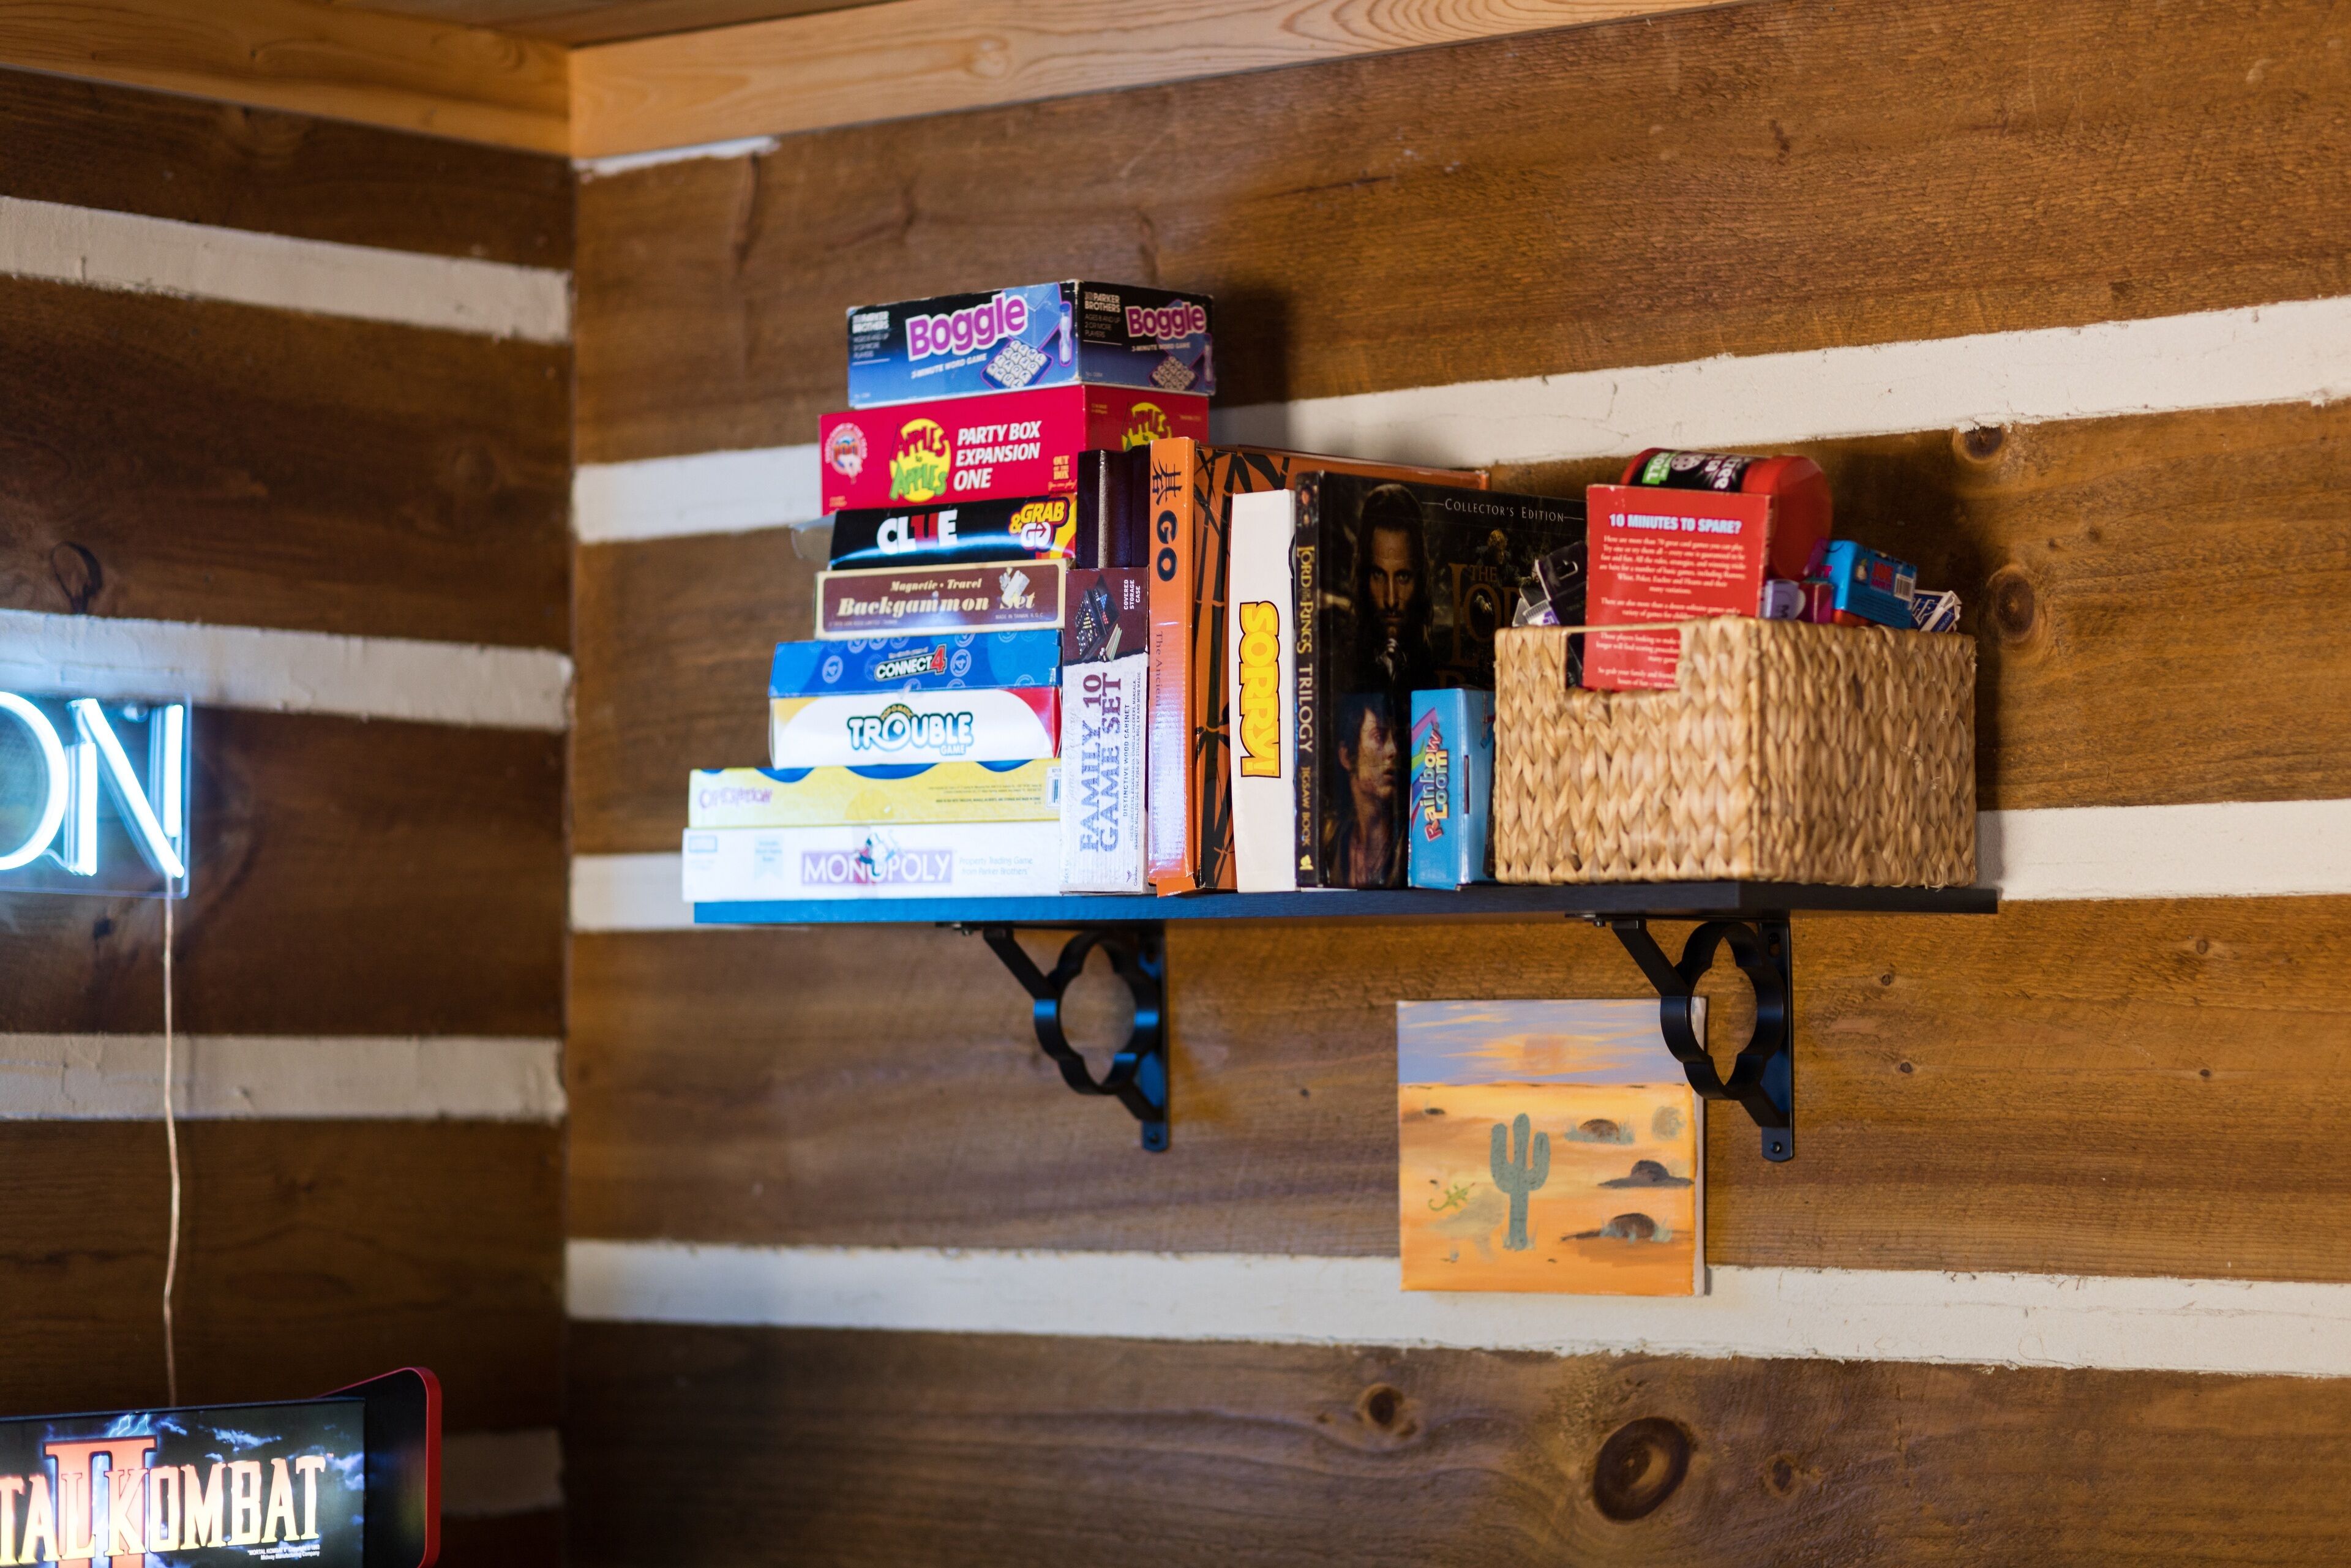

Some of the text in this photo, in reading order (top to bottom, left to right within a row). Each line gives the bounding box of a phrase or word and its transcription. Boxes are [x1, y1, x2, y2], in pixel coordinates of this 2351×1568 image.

[1084, 301, 1120, 313] BROTHERS
[1093, 292, 1120, 303] PARKER
[906, 292, 1029, 362] Boggle
[1125, 301, 1207, 340] Boggle
[966, 353, 988, 365] GAME
[957, 421, 1042, 447] PARTY BOX
[955, 442, 1041, 468] EXPANSION
[1053, 455, 1070, 465] OUT
[890, 460, 948, 501] APPLES
[953, 467, 993, 492] ONE
[1020, 501, 1066, 525] GRAB
[1445, 498, 1564, 523] COLLECTOR'S EDITION
[1609, 514, 1742, 535] 10 MINUTES TO SPARE?
[877, 510, 958, 555] CLUE
[1010, 512, 1051, 549] & GO
[1157, 509, 1179, 582] GO
[1296, 544, 1316, 588] LORD
[1469, 565, 1498, 582] THE
[890, 578, 982, 593] Magnetic Travel
[837, 596, 989, 618] Backgammon
[1296, 601, 1314, 655] RINGS
[876, 655, 933, 679] CONNECT
[931, 646, 945, 672] 4
[1241, 603, 1278, 775] SORRY!
[1299, 662, 1314, 753] TRILOGY
[848, 711, 973, 752] TROUBLE
[940, 745, 966, 756] GAME
[1079, 674, 1102, 853] FAMILY 10
[1100, 672, 1122, 852] GAME SET
[1301, 767, 1311, 808] JIGSAW
[1419, 729, 1443, 842] Rainbow
[1433, 749, 1449, 820] Loom
[1301, 812, 1311, 846] BOOK
[803, 852, 951, 883] MONOPOLY
[989, 855, 1012, 866] Trading
[1013, 856, 1034, 865] Game
[103, 1454, 326, 1557] KOMBAT
